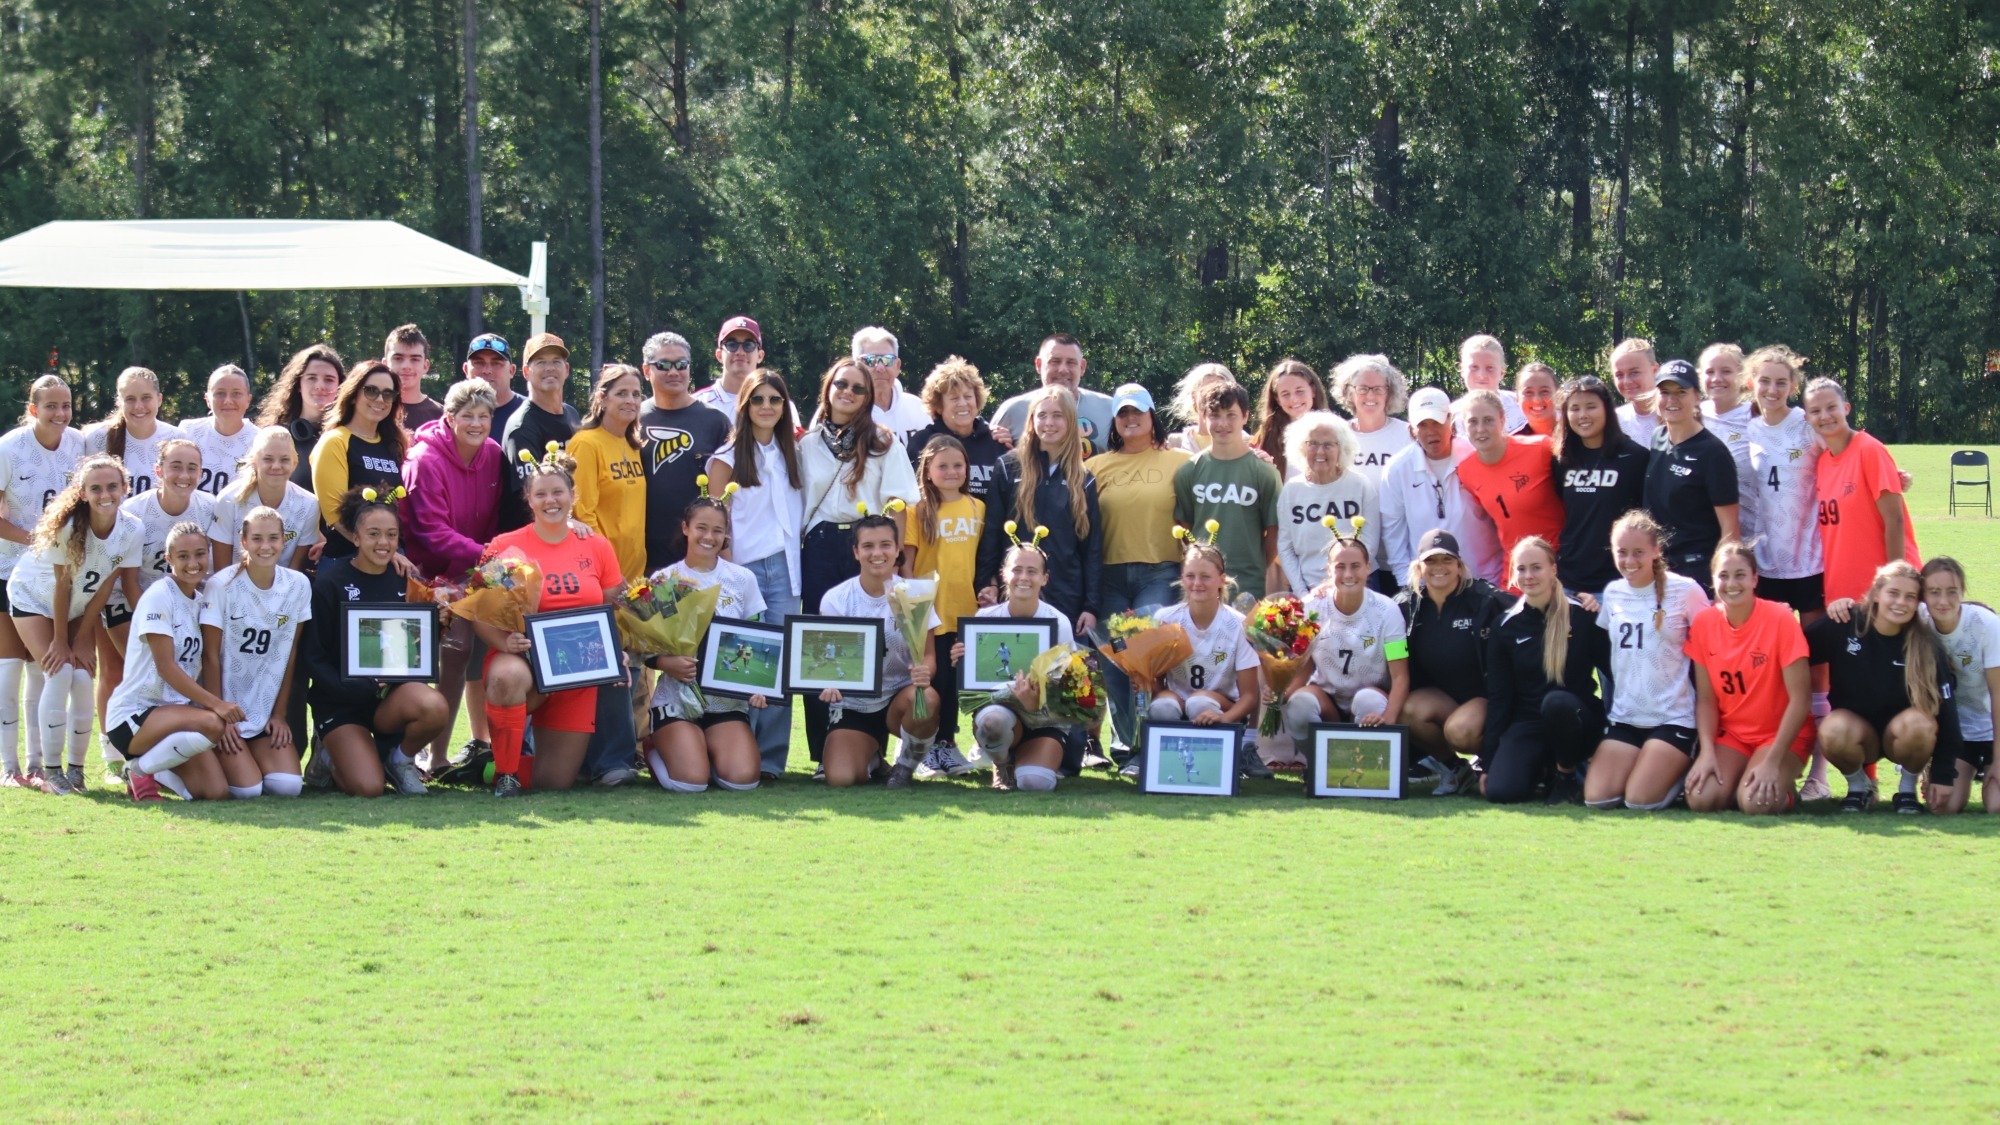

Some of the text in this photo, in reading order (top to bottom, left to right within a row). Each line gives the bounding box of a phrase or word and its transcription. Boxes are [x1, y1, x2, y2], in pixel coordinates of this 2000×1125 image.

[362, 455, 399, 474] BEES
[1353, 452, 1392, 467] CAD
[1669, 464, 1692, 476] SCAD
[197, 468, 229, 496] 20
[1105, 468, 1164, 488] SCAD
[1563, 469, 1619, 487] SCAD
[1767, 465, 1781, 492] 4
[1192, 483, 1259, 507] SCAD
[1496, 494, 1511, 519] 1
[1291, 501, 1360, 525] SCAD
[937, 517, 978, 538] CAD
[153, 550, 173, 573] 2
[82, 570, 101, 593] 2
[545, 572, 580, 595] 30
[146, 613, 162, 621] SUN
[239, 627, 272, 655] 29
[1619, 622, 1644, 650] 21
[1338, 649, 1353, 675] 7
[1190, 664, 1205, 690] 8
[1719, 670, 1747, 695] 31
